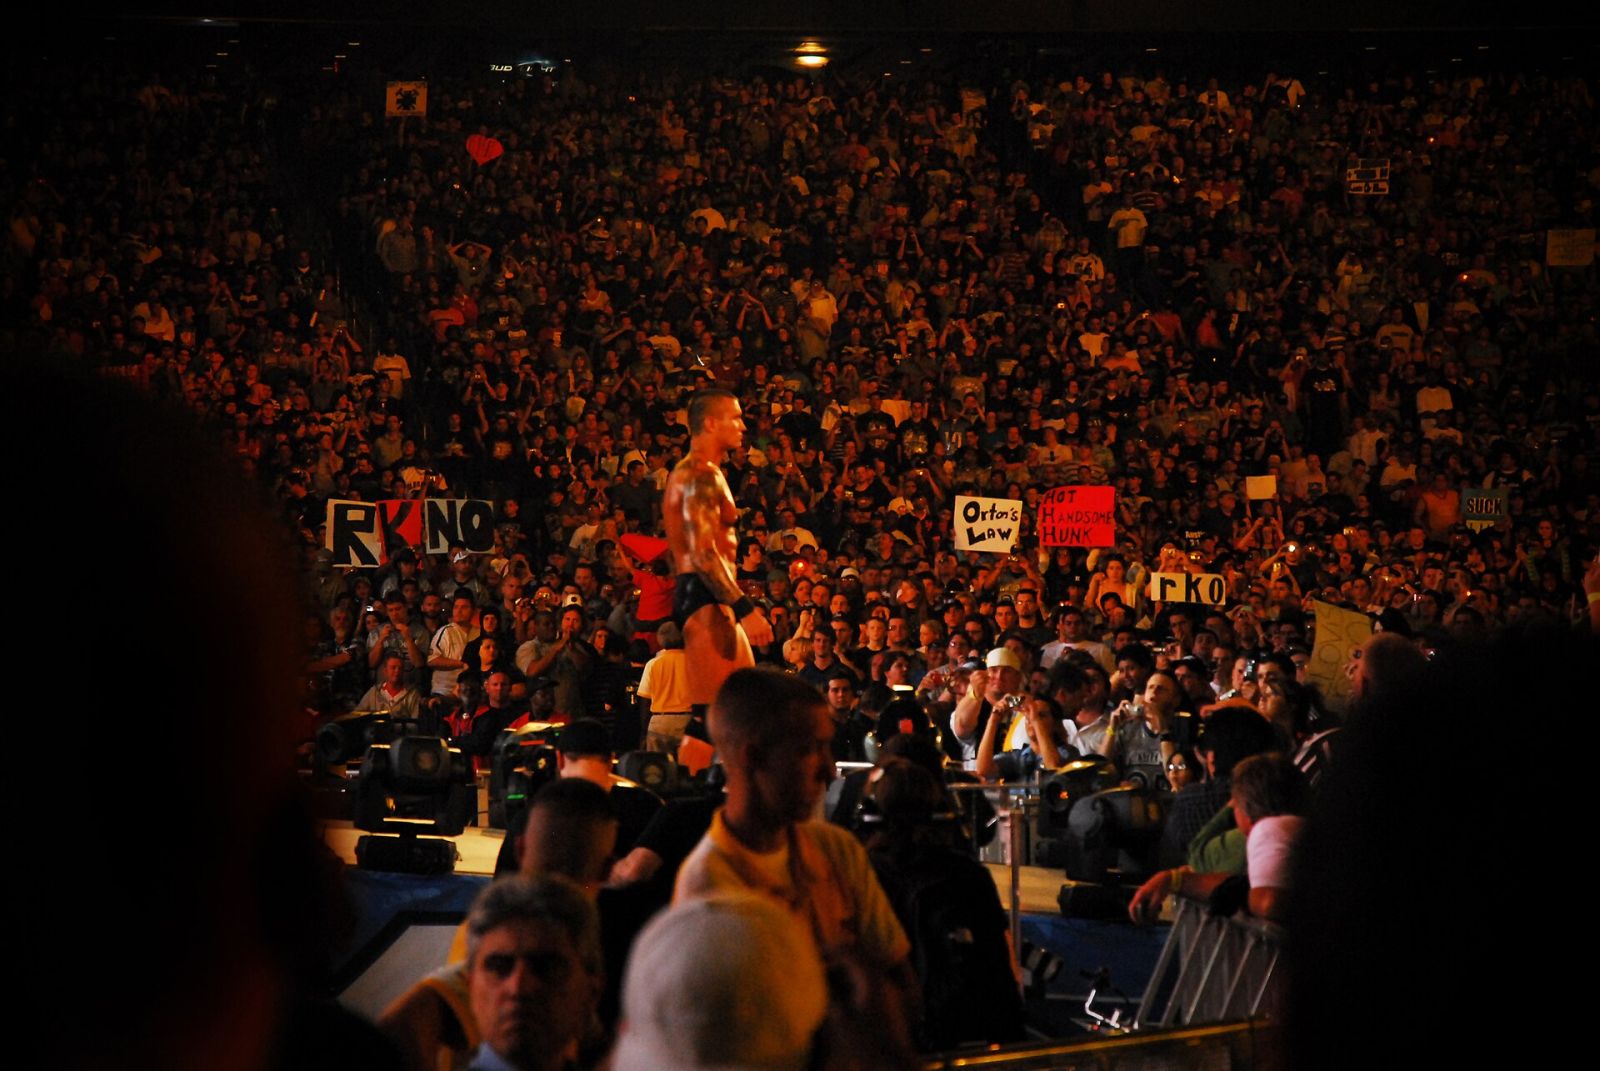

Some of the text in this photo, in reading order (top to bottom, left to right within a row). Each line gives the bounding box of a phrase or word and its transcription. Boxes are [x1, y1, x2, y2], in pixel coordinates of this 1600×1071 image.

[1043, 489, 1077, 504] HOT
[1466, 496, 1503, 515] SUCK
[963, 500, 1018, 524] Orton's
[1042, 506, 1112, 525] HANDSOME
[1042, 525, 1095, 545] HUNK
